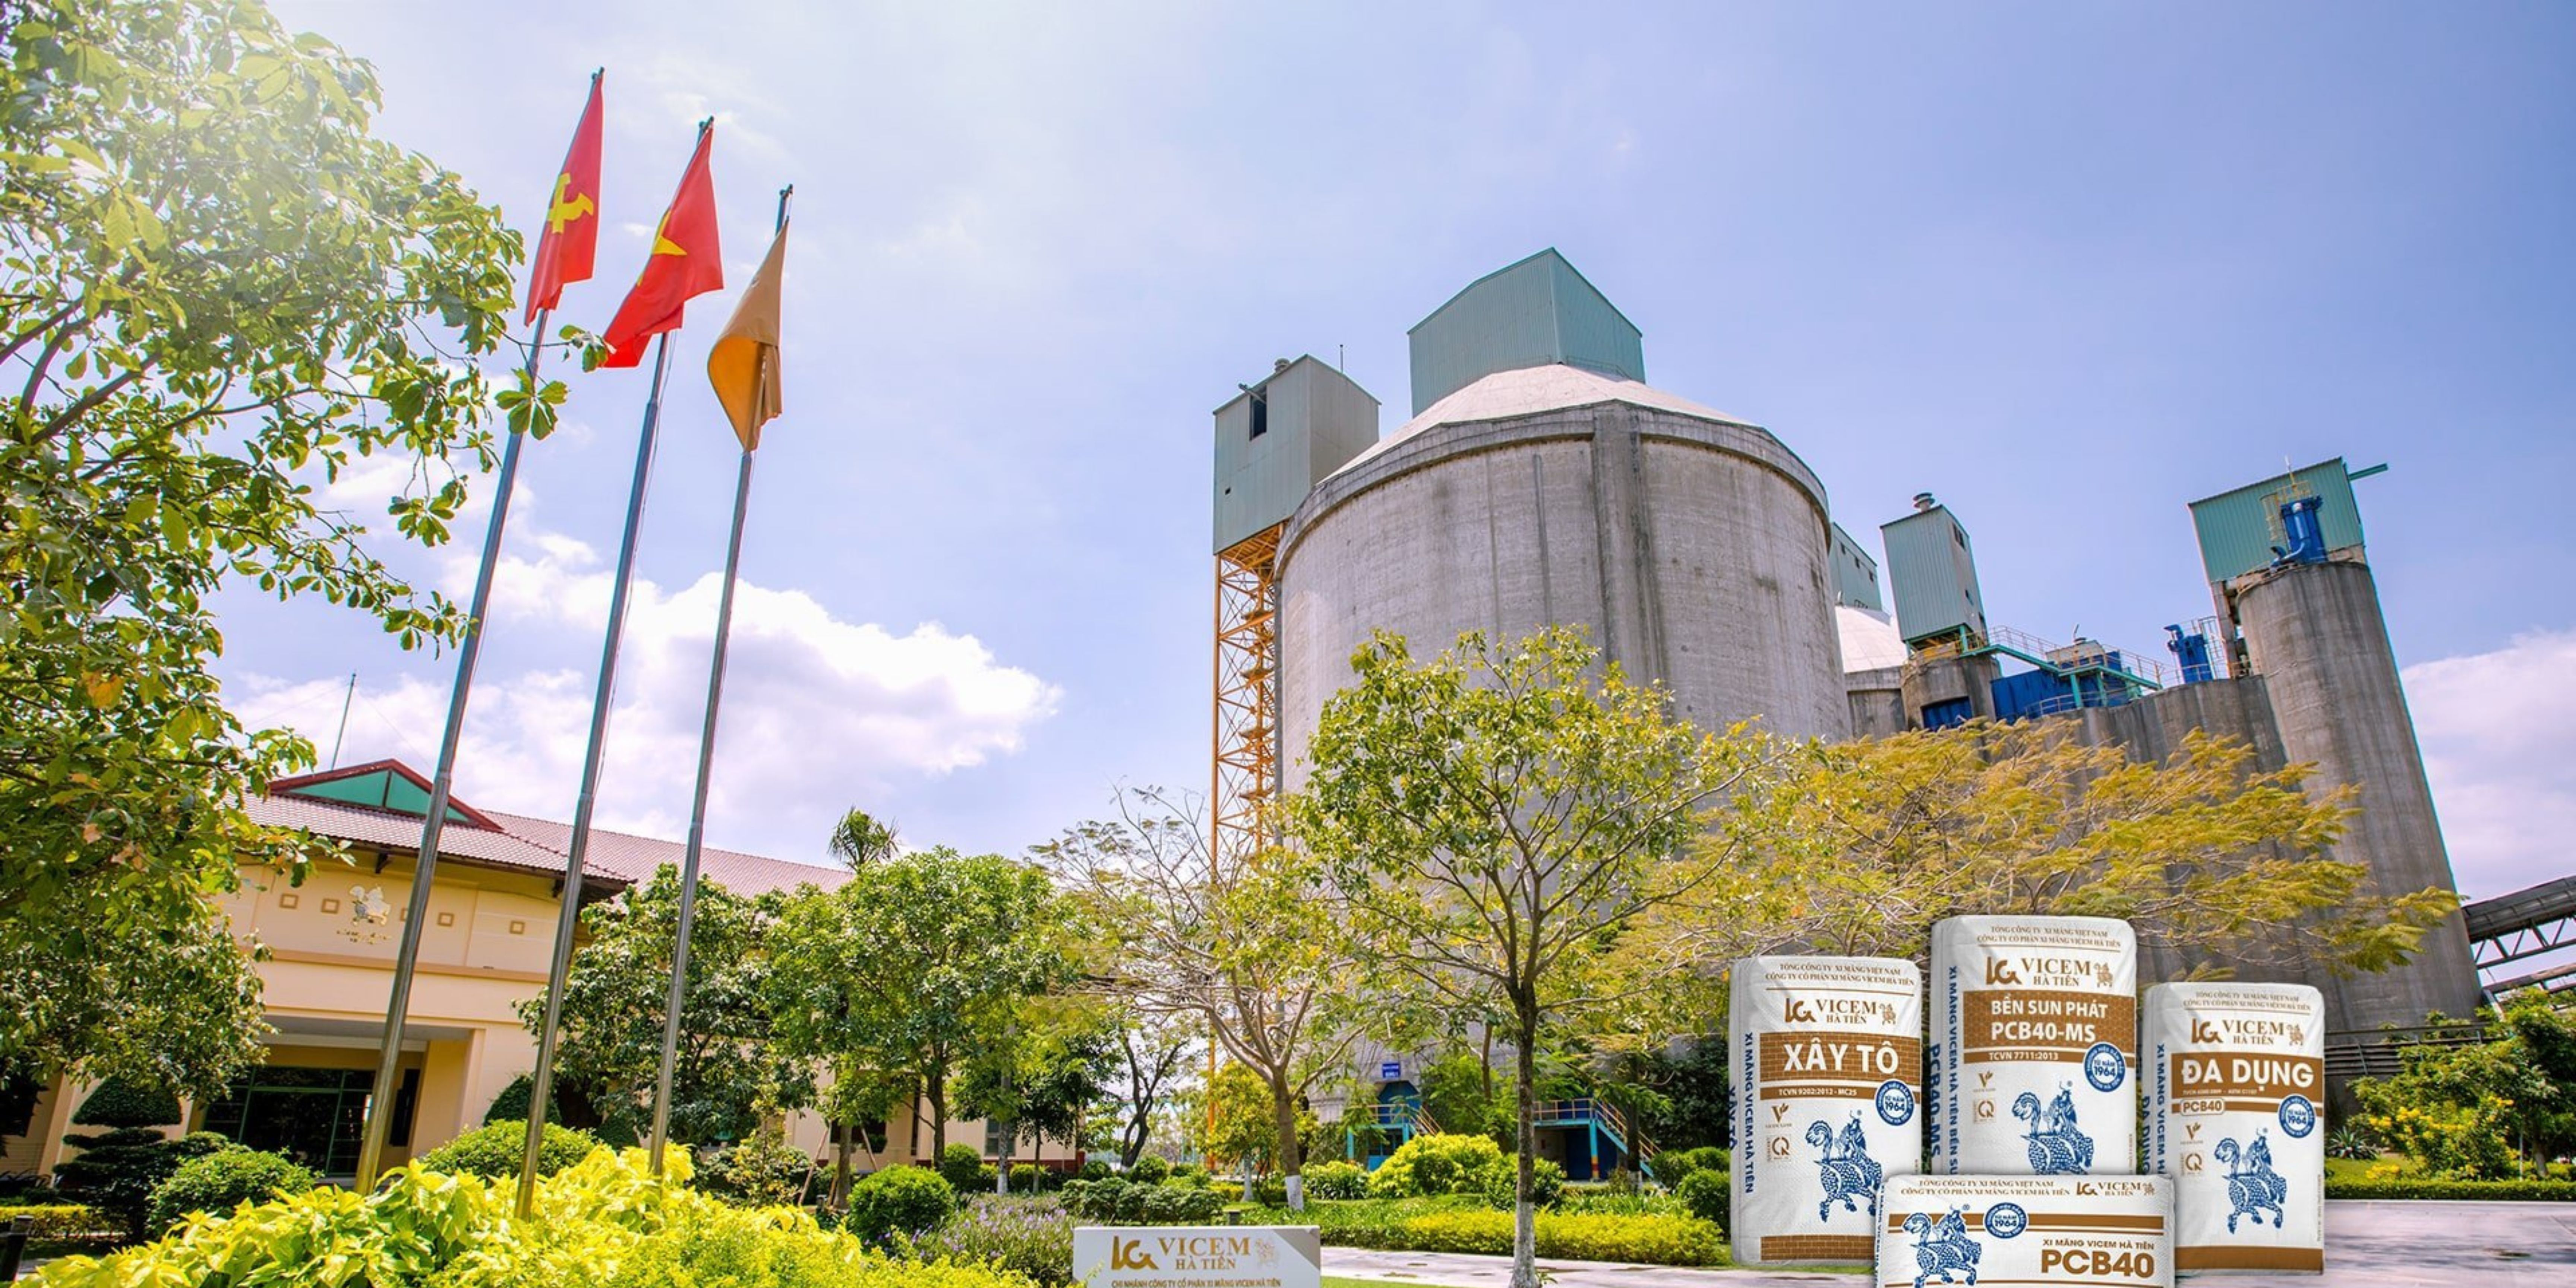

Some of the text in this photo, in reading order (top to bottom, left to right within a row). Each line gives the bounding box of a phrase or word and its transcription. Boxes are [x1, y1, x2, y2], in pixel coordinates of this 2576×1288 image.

[1949, 966, 1957, 980] XI
[2021, 958, 2091, 976] VICEM
[2033, 974, 2080, 986] HÀ TIÊN
[1816, 999, 1877, 1015] VICEM
[1991, 993, 2108, 1019] BỀN SUN PHÁT
[1826, 1013, 1867, 1024] HÀ TIÊN
[1991, 1022, 2096, 1042] PCB40-MS
[2222, 1020, 2284, 1035] VICEM
[2233, 1034, 2274, 1045] HÀ TIÊN
[1949, 1026, 1957, 1070] VICEM
[2157, 1044, 2165, 1058] XI
[1784, 1037, 1899, 1074] XÂY TÔ
[1989, 1051, 2059, 1061] TCVN 7711:2013
[2094, 1066, 2115, 1077] 1964
[2181, 1058, 2314, 1091] ĐA DỤNG
[1885, 1101, 1905, 1111] 1964
[1929, 1044, 1941, 1158] PCB40-MS
[2183, 1101, 2222, 1113] PCB40
[1745, 1032, 1755, 1193] XI MĂNG VICEM HÀ TIÊN
[2288, 1115, 2307, 1125] 1964
[1949, 1158, 1957, 1175] SU
[2098, 1182, 2141, 1190] VICEM
[1158, 1237, 1251, 1256] VICEM
[2055, 1238, 2084, 1247] MĂNG
[2087, 1240, 2116, 1248] VICEM
[2119, 1241, 2133, 1249] HÀ
[2136, 1241, 2154, 1250] TIÊN
[1175, 1256, 1236, 1270] HÀ TIÊN
[2041, 1249, 2154, 1279] PCB40
